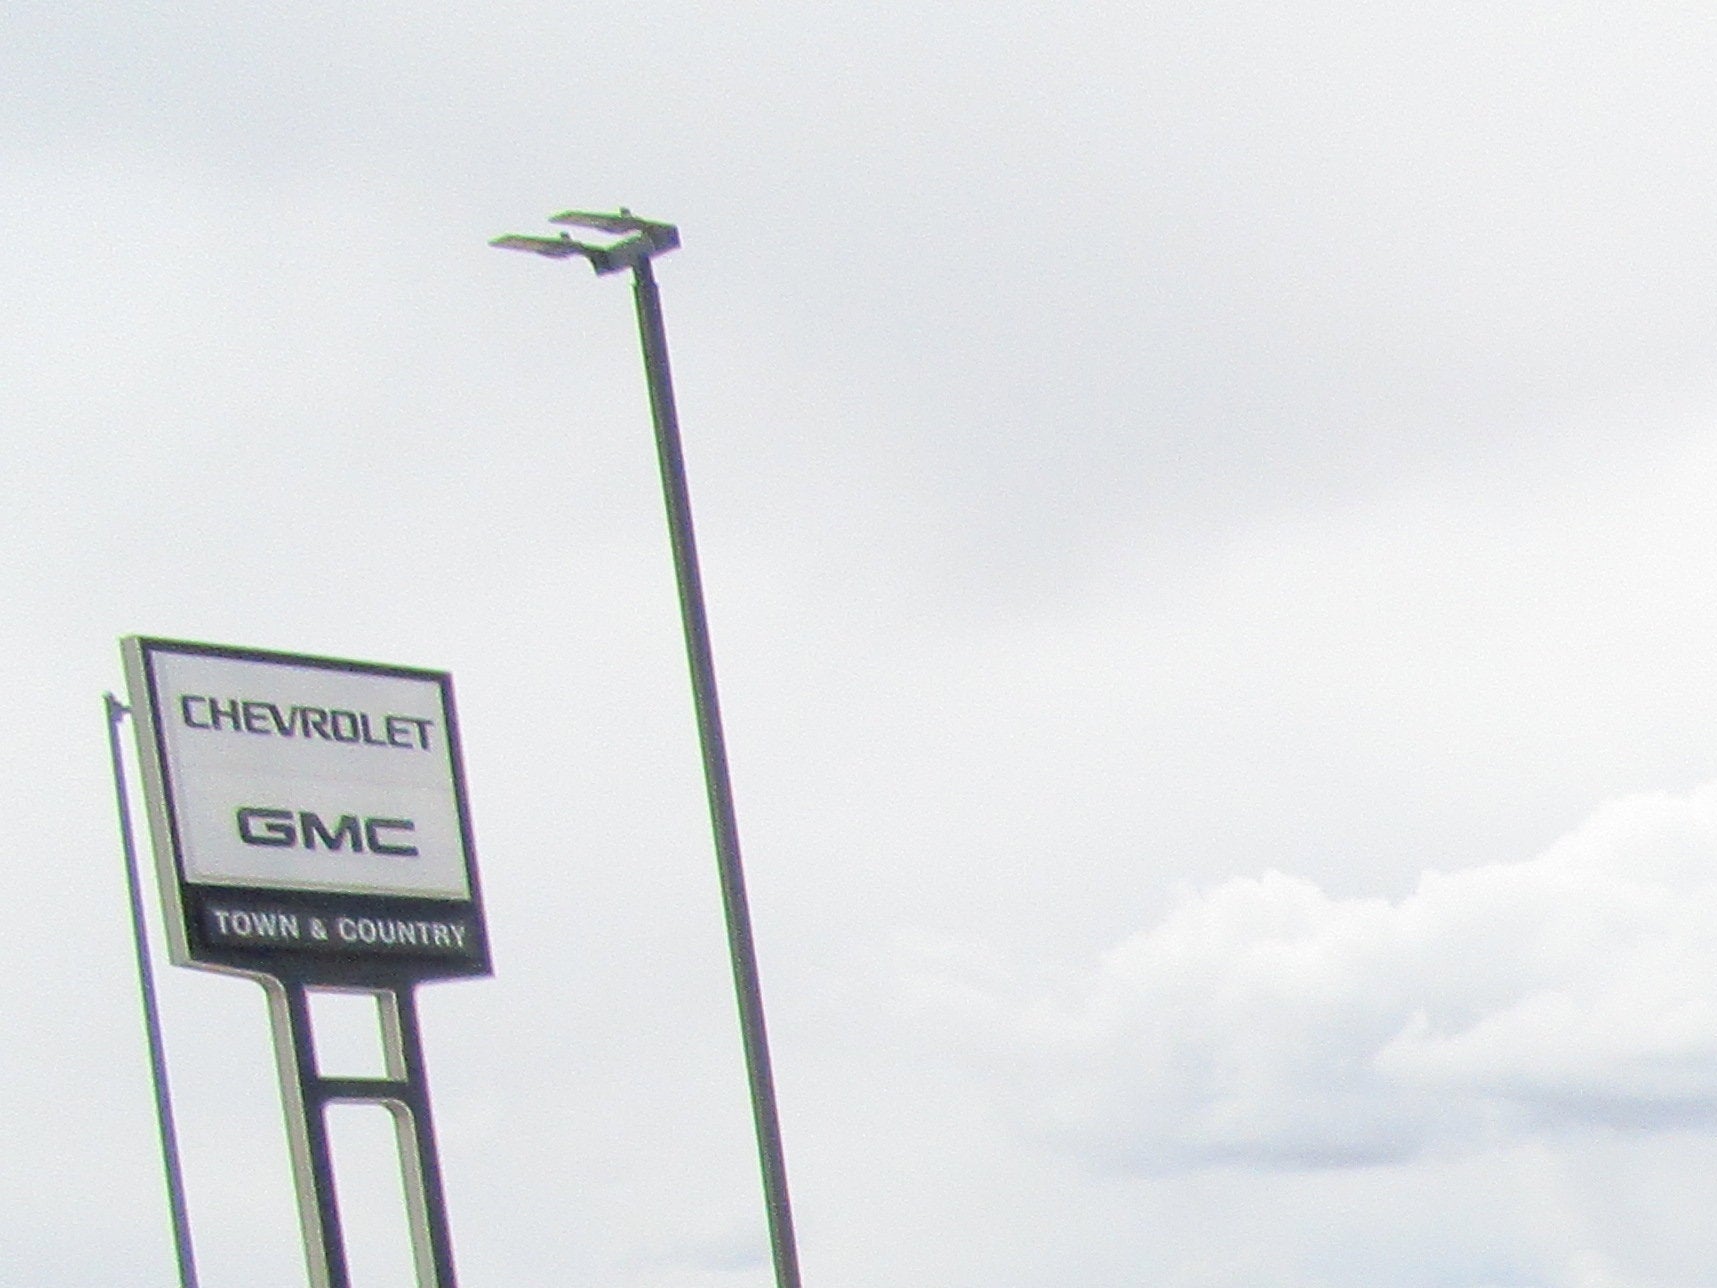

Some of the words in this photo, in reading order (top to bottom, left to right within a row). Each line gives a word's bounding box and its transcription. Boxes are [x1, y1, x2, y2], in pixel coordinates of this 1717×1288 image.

[180, 694, 435, 751] CHEVROLET
[236, 806, 420, 857] GMC
[214, 908, 299, 939] TOWN
[311, 917, 328, 941] &
[338, 917, 468, 948] COUNTRY
